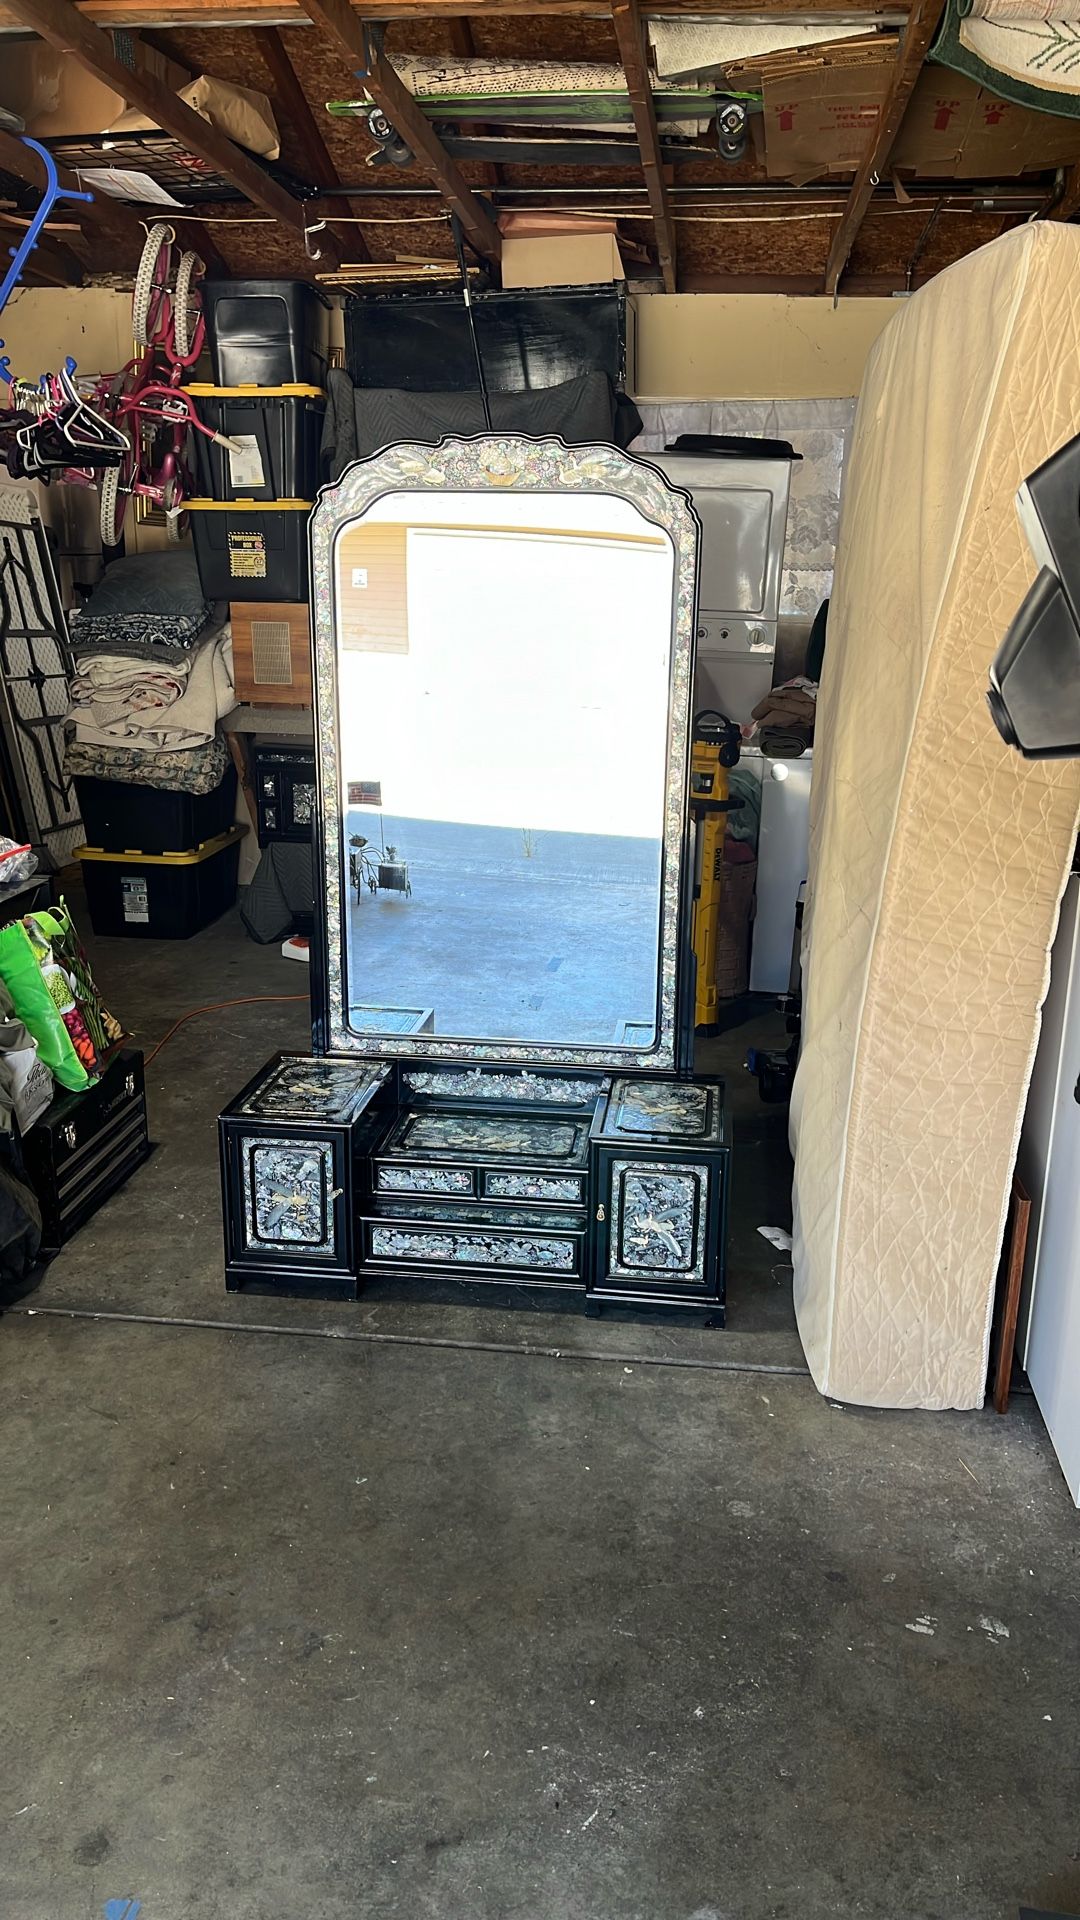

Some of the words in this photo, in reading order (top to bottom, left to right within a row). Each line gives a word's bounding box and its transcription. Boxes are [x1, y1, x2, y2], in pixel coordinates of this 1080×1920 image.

[775, 103, 799, 112] UP
[935, 99, 961, 108] UP
[984, 103, 1011, 112] UP
